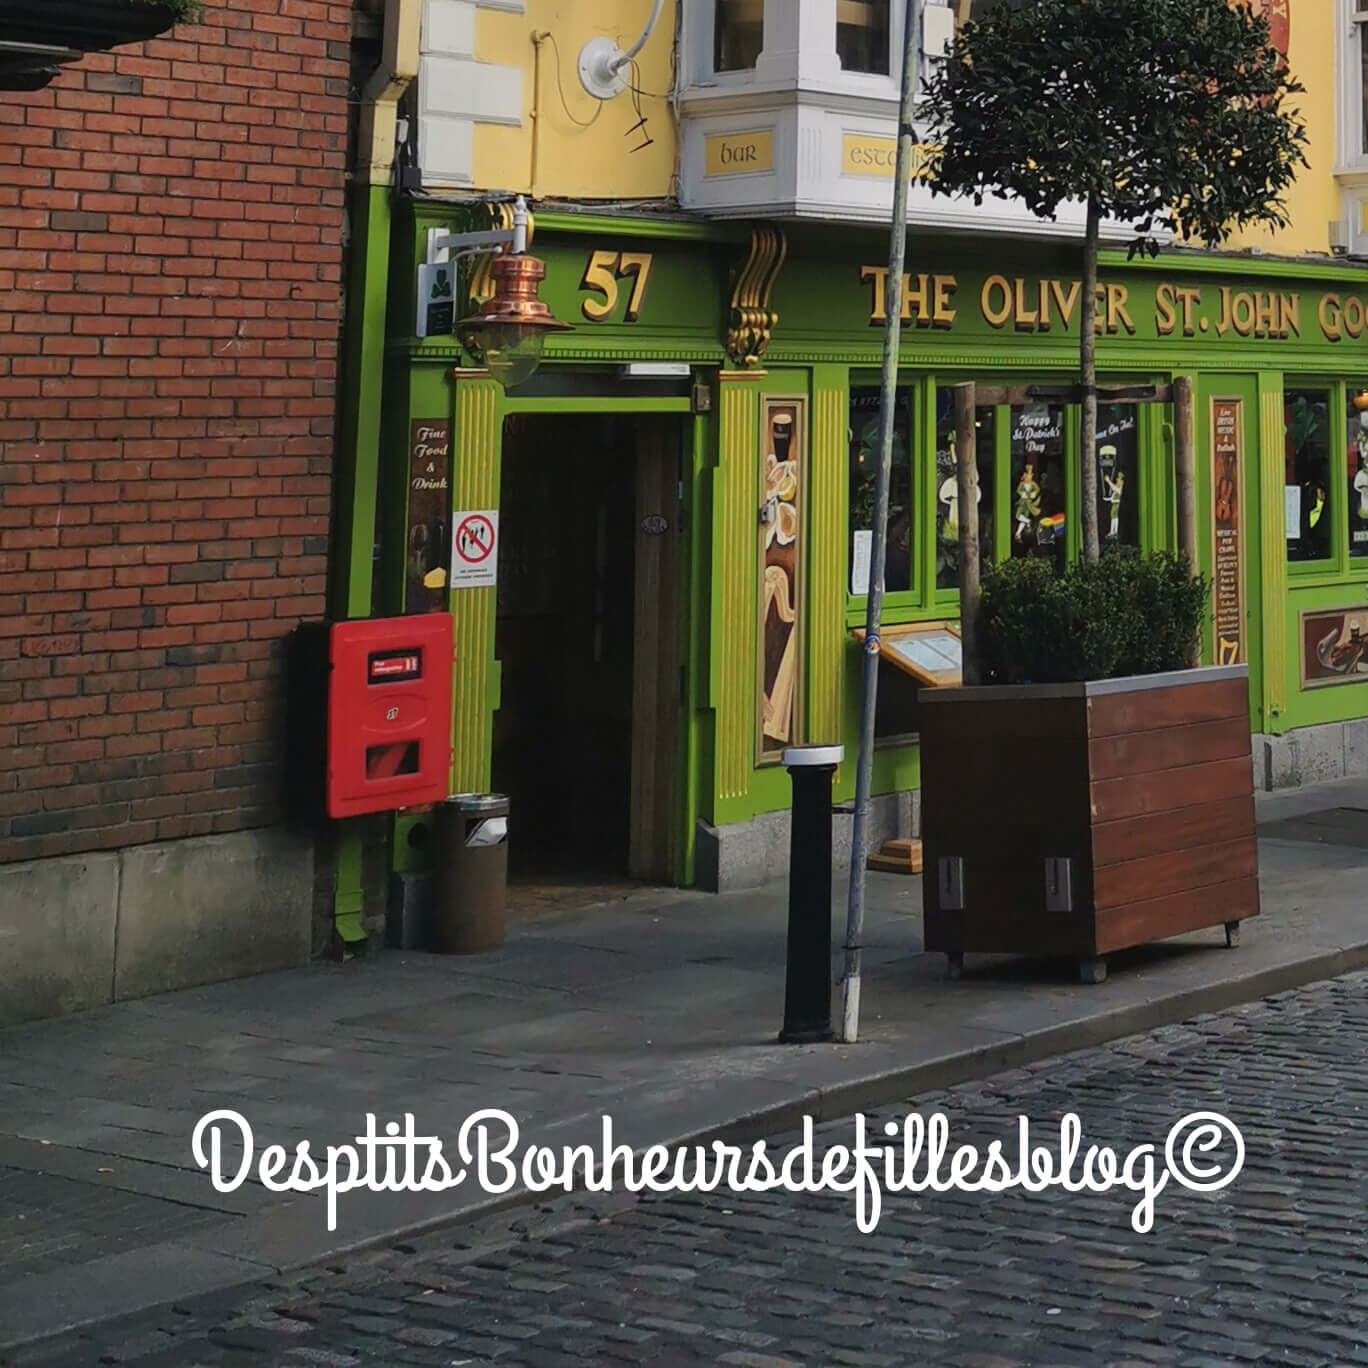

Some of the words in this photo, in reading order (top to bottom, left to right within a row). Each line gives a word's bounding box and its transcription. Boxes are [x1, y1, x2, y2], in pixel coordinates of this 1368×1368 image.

[580, 249, 654, 323] 57
[859, 264, 958, 330] THE
[1214, 286, 1301, 339] JOHN
[417, 427, 446, 441] Fine
[414, 444, 448, 459] Food
[426, 462, 435, 473] &
[412, 477, 448, 490] Drink
